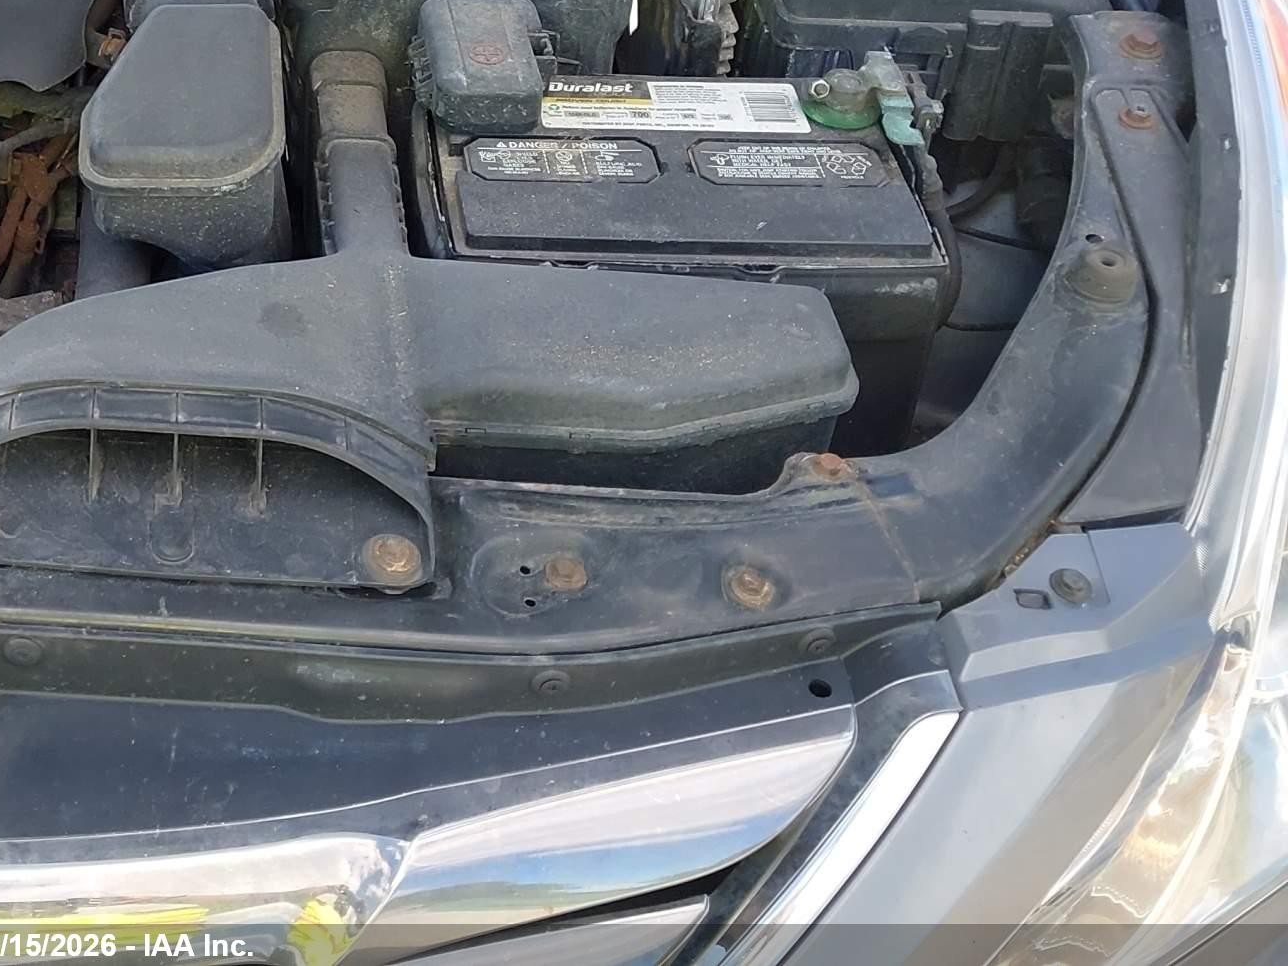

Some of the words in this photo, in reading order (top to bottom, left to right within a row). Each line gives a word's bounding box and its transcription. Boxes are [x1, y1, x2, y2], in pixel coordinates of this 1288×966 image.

[548, 81, 634, 94] Duralast
[632, 111, 650, 119] 700
[509, 141, 560, 149] DANGER
[571, 142, 618, 150] POISON
